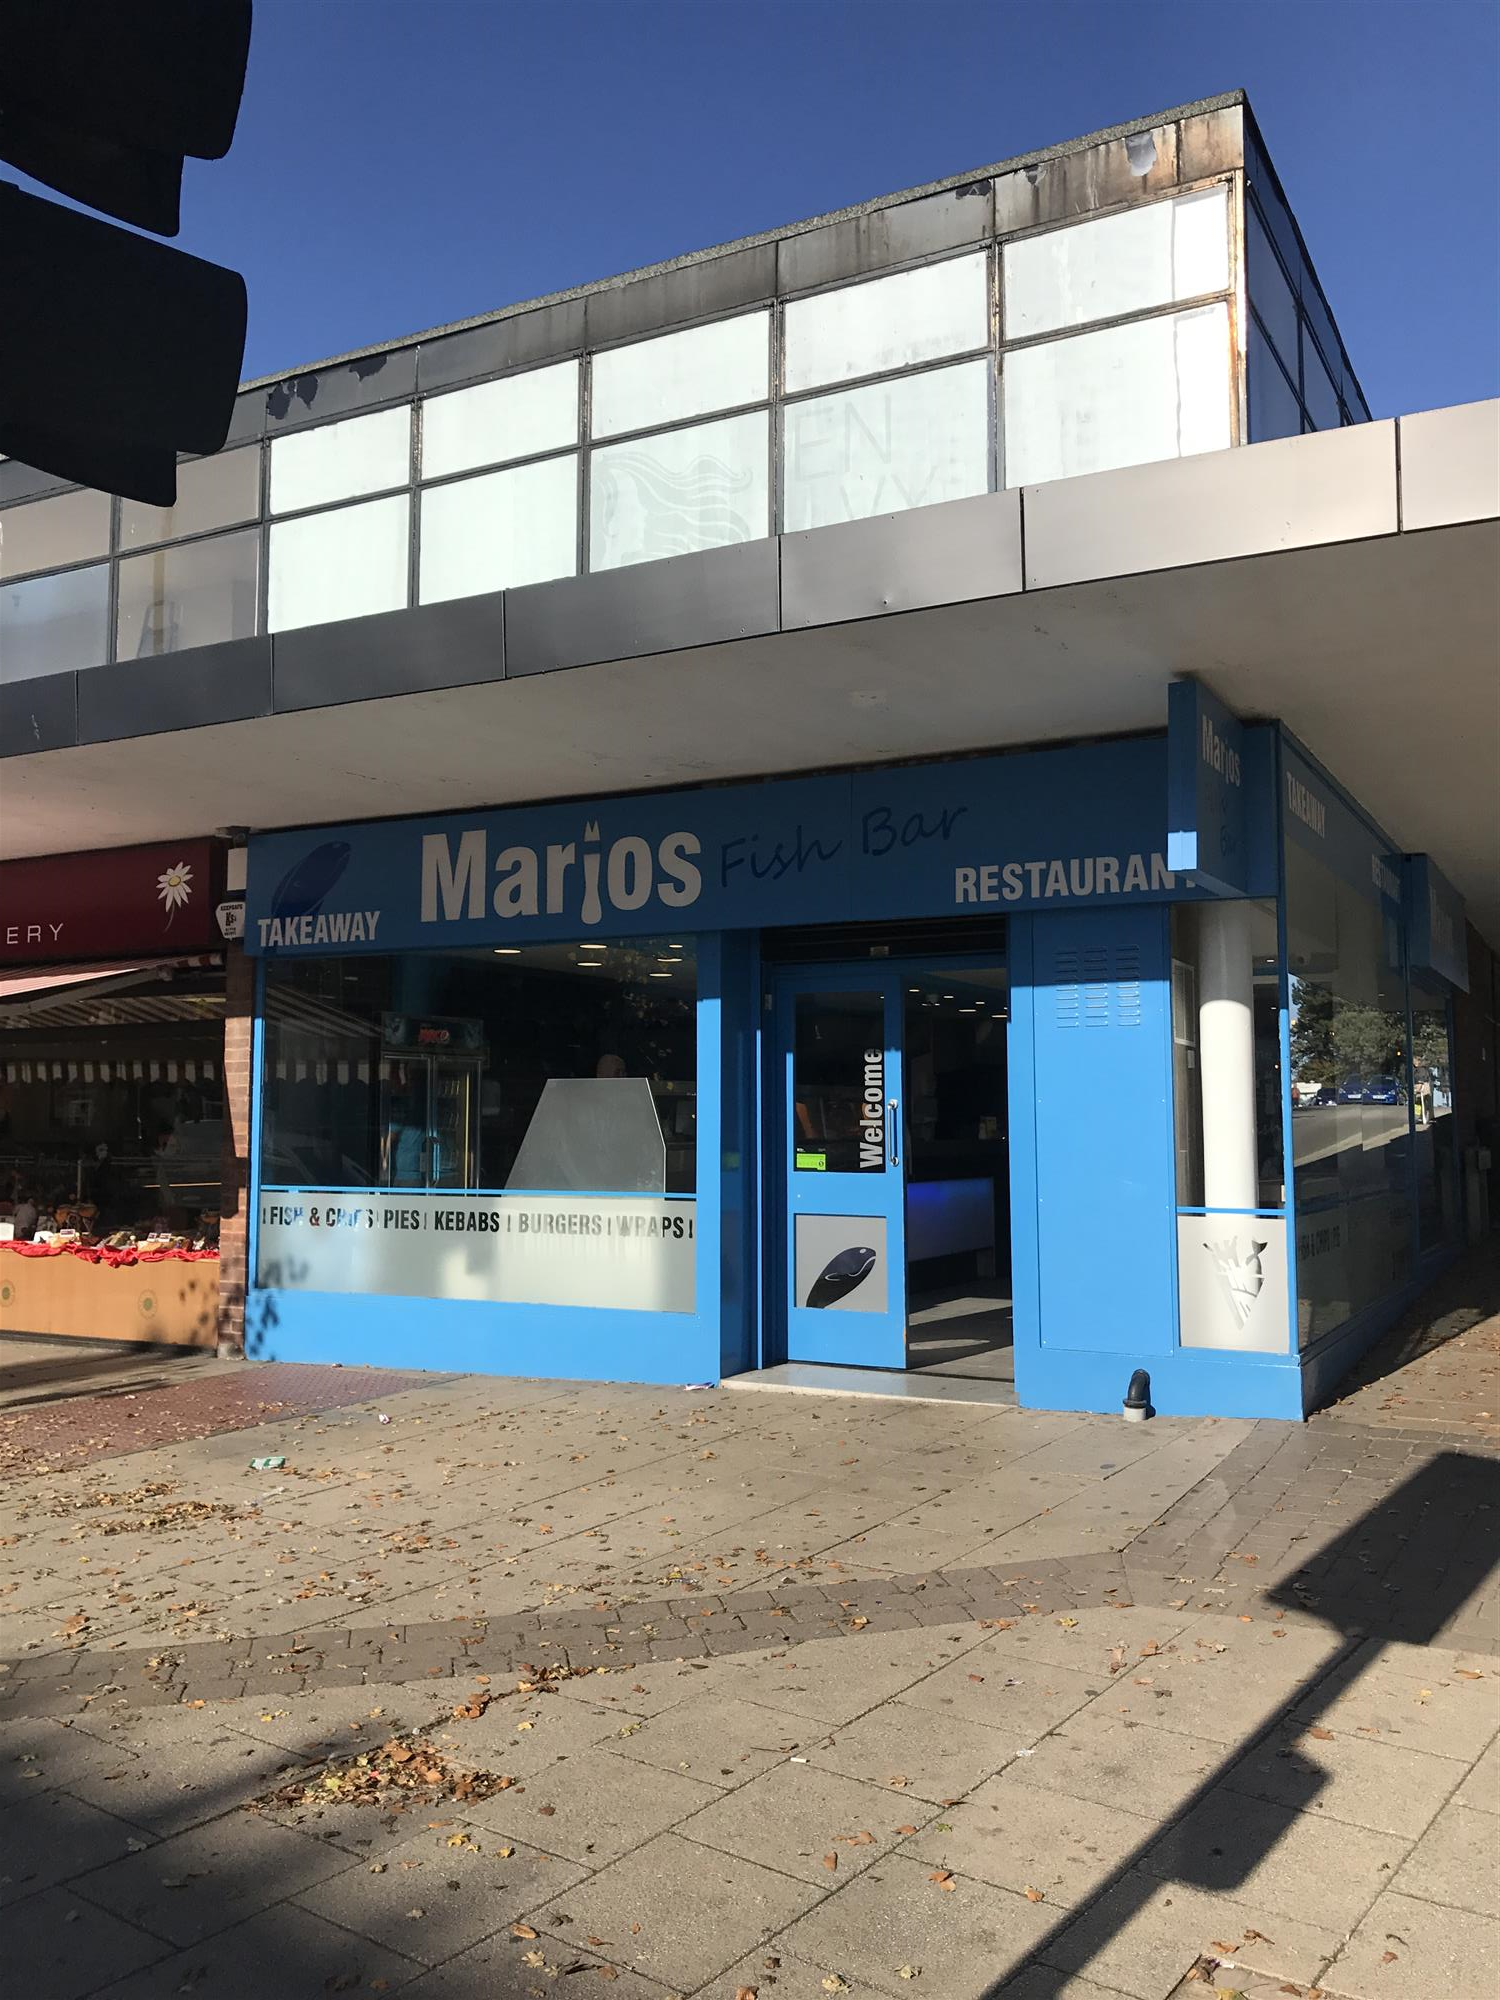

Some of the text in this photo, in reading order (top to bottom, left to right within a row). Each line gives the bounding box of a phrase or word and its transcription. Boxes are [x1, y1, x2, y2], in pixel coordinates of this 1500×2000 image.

[1201, 714, 1241, 787] Marios
[1286, 771, 1326, 839] TAKEAWAY
[420, 806, 969, 925] Marios Fish Bar
[955, 852, 1196, 904] RESTAURAN
[6, 923, 64, 945] ERY
[257, 910, 381, 948] TAKEAWAY
[860, 1048, 883, 1168] Welcome
[270, 1206, 304, 1226] FISH
[309, 1207, 320, 1226] &
[384, 1209, 420, 1230] PIES
[434, 1211, 501, 1233] KEBABS
[518, 1213, 602, 1235] BURGERS
[616, 1215, 684, 1239] WRAPS
